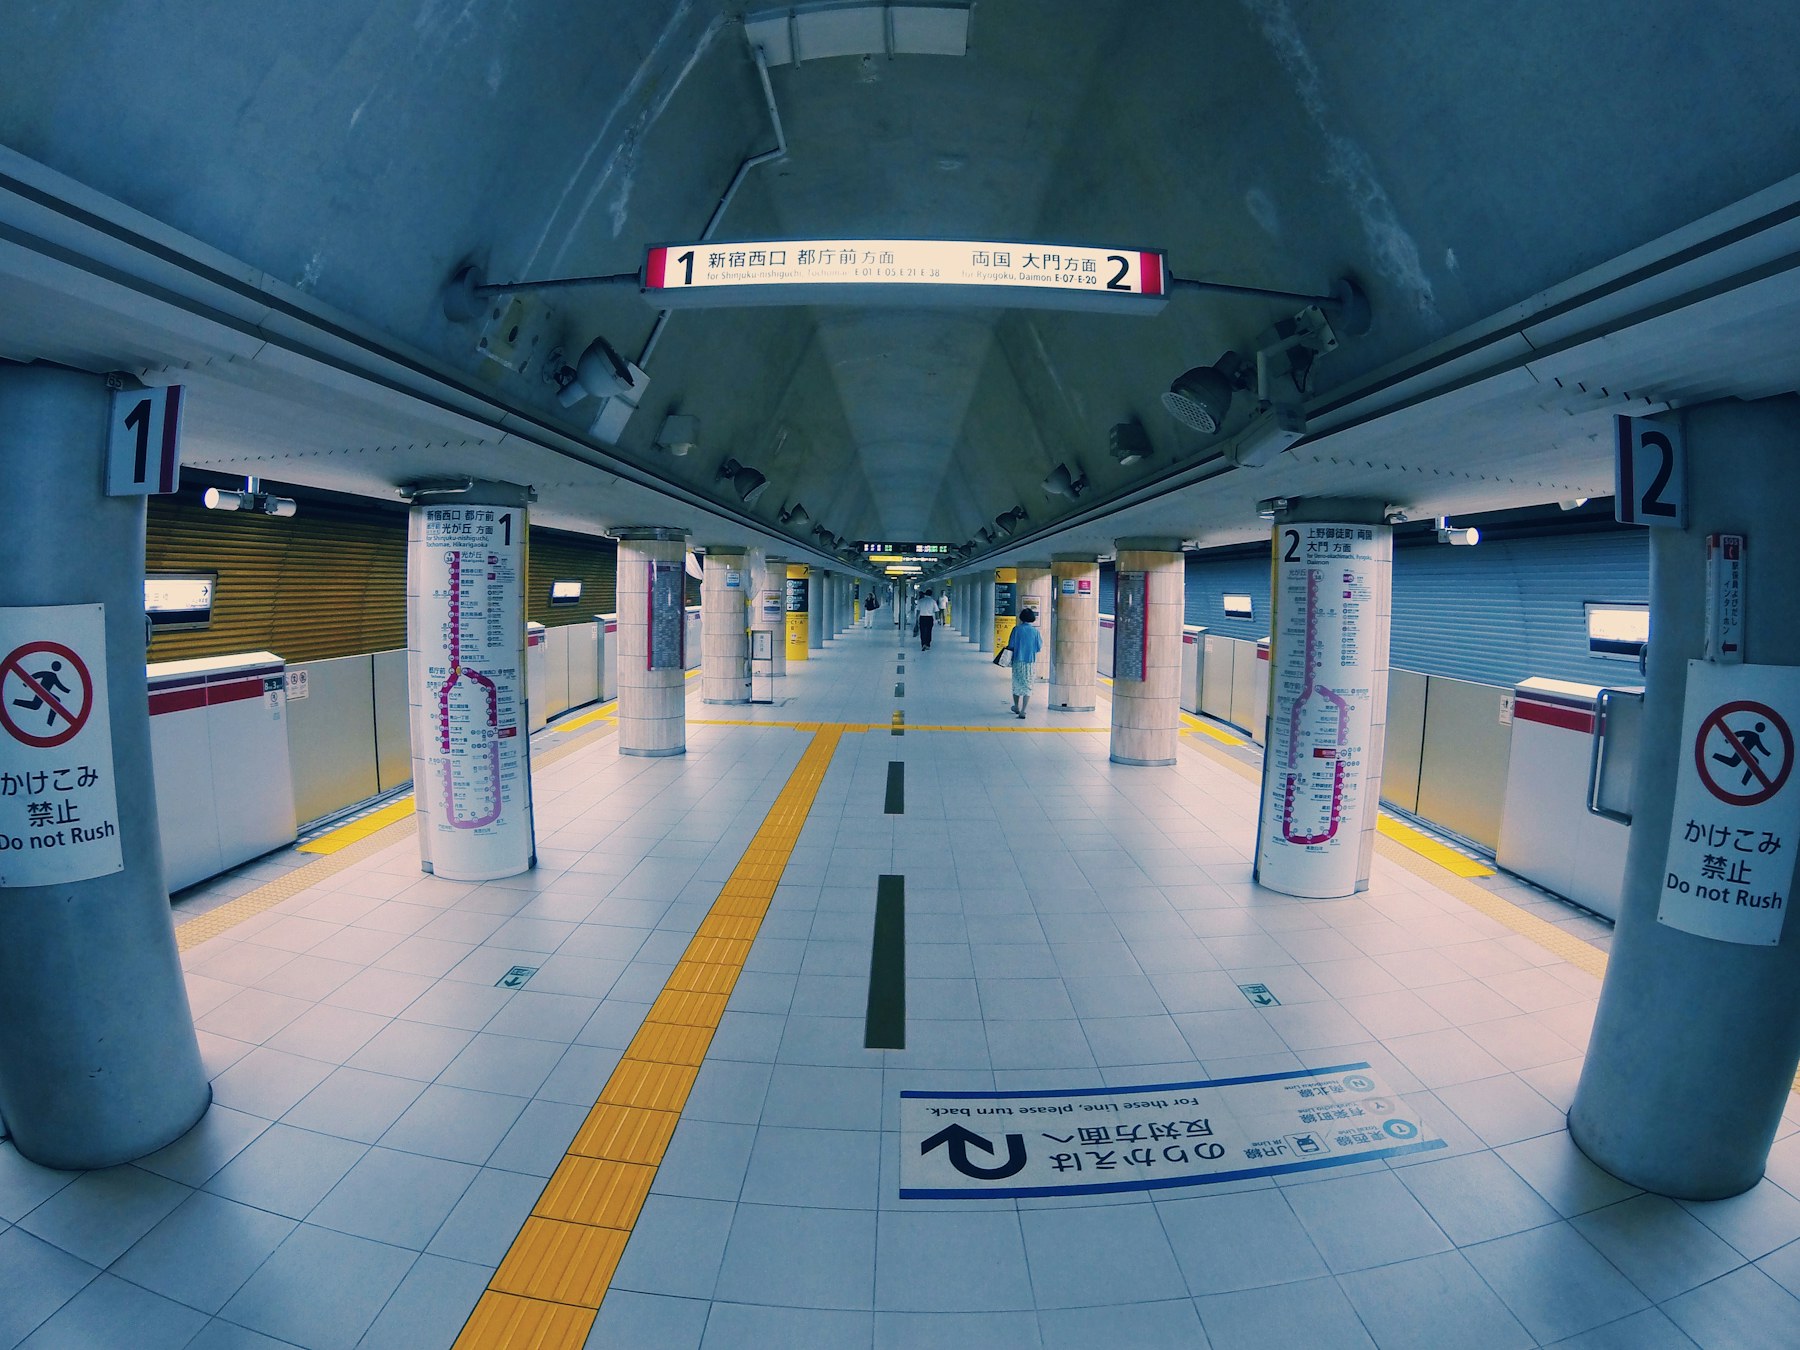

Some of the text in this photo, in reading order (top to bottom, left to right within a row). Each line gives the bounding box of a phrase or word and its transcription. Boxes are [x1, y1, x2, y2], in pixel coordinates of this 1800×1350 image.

[677, 251, 695, 285] 1
[708, 250, 787, 269] 新宿西口
[972, 250, 1011, 268] 両国
[706, 271, 719, 280] for
[1019, 272, 1052, 282] Daimon
[1106, 255, 1132, 291] 2
[124, 399, 152, 484] 1
[1641, 430, 1677, 518] 2
[427, 510, 495, 522] 新宿西口 都庁前
[442, 523, 472, 535] 光が丘
[476, 525, 494, 535] 方面
[498, 513, 512, 546] 1
[1307, 527, 1373, 541] 上野御徒町 両国
[1284, 529, 1301, 563] 2
[1307, 541, 1352, 553] 大門 方面
[1724, 537, 1739, 545] SOS
[1722, 580, 1730, 635] インターホン
[0, 765, 99, 796] かけこみ
[27, 798, 81, 828] 禁止
[0, 820, 115, 850] Do not Rush
[1684, 819, 1782, 855] かけこみ
[1701, 853, 1752, 885] 禁止
[1666, 872, 1783, 909] Do not Rush
[1298, 1084, 1347, 1098] 南北線
[1352, 1080, 1366, 1088] N
[926, 1097, 1199, 1117] For these Line, please turn back.
[1298, 1106, 1366, 1124] 有楽町線
[1041, 1118, 1213, 1145] 反対方面へ
[1335, 1130, 1388, 1147] 東西線
[1049, 1142, 1226, 1173] のりかえは
[1243, 1145, 1288, 1160] JR線
